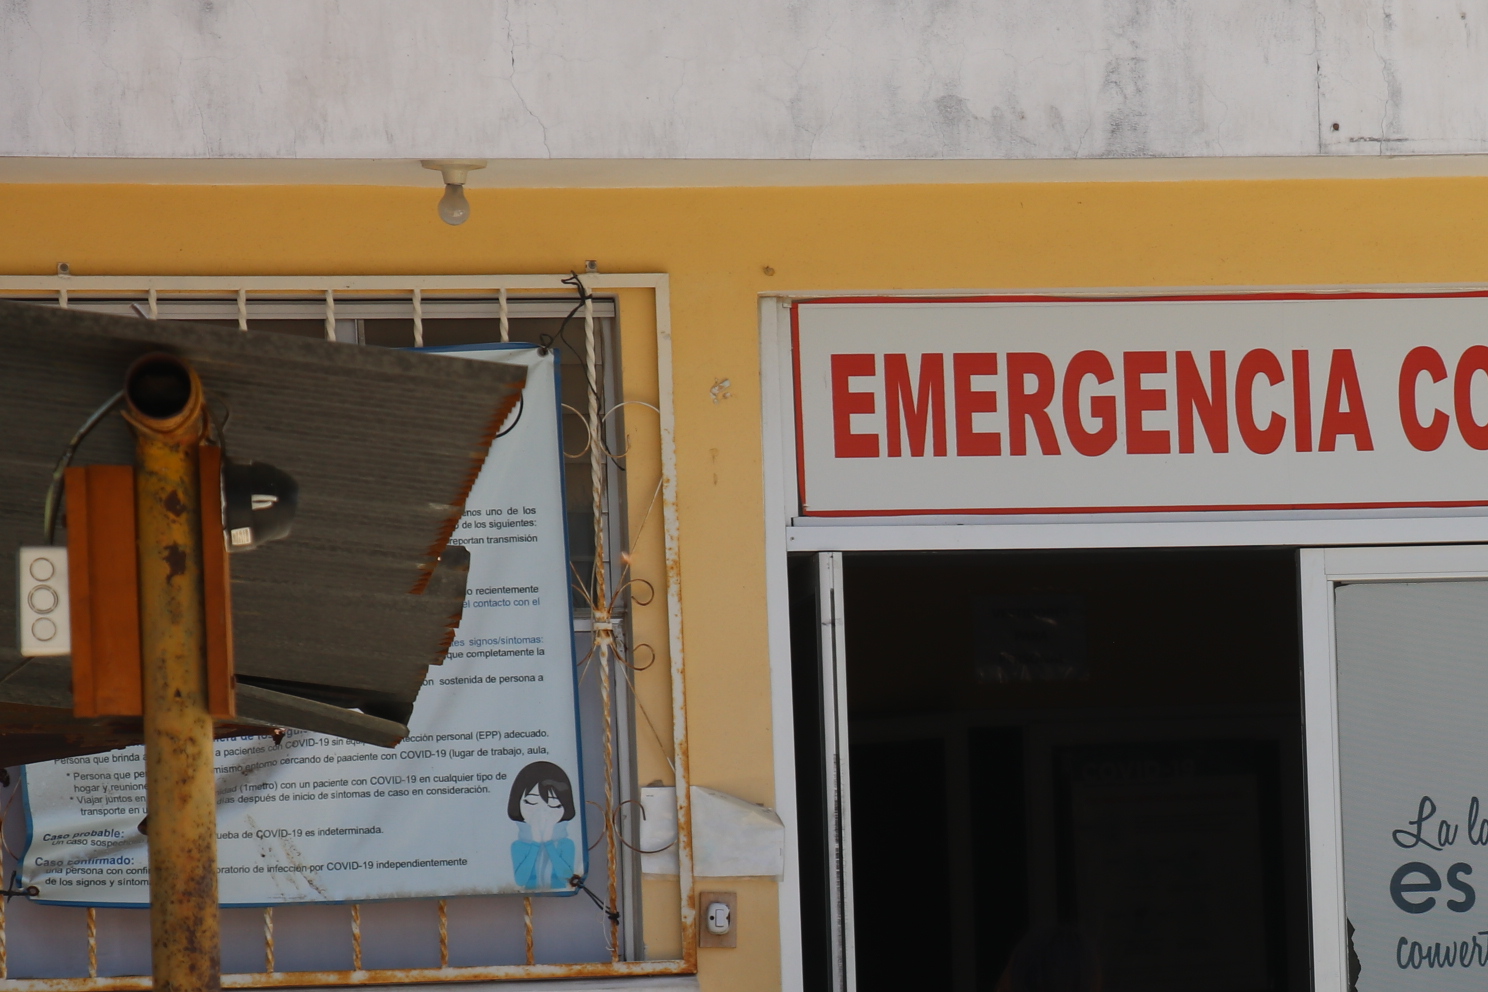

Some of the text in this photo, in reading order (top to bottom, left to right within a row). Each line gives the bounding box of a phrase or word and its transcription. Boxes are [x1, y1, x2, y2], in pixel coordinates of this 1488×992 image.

[830, 347, 1373, 458] EMERGENCIA
[486, 506, 536, 516] uno de los
[462, 518, 537, 530] de los siguientes:
[487, 534, 538, 544] transmisión
[475, 585, 539, 595] recientemente
[473, 598, 511, 608] contacto
[532, 598, 540, 606] el
[469, 636, 544, 647] signos/síntomas:
[466, 648, 534, 659] completamente
[537, 648, 545, 656] la
[440, 676, 483, 686] sostenida
[485, 675, 497, 684] de
[499, 676, 536, 685] persona
[436, 729, 549, 742] personal (EPP) adecuado.
[323, 755, 335, 764] de
[337, 753, 378, 764] paaciente
[400, 750, 447, 760] COVID-19
[449, 748, 474, 760] (lugar
[477, 747, 488, 757] de
[491, 746, 525, 758] trabajo,
[527, 746, 549, 755] aula,
[313, 778, 348, 789] paciente
[351, 778, 367, 786] con
[370, 776, 417, 785] COVID-19
[433, 774, 473, 785] cualquier
[476, 773, 493, 783] tipo
[496, 772, 507, 780] de
[238, 793, 276, 804] después
[279, 792, 290, 801] de
[293, 791, 315, 800] inicio
[318, 791, 328, 800] de
[331, 789, 371, 799] síntomas
[374, 789, 385, 798] de
[388, 789, 409, 797] caso
[426, 785, 490, 795] consideración.
[1392, 795, 1458, 851] La
[309, 858, 468, 874] por COVID-19 independientemente
[1389, 861, 1476, 914] es
